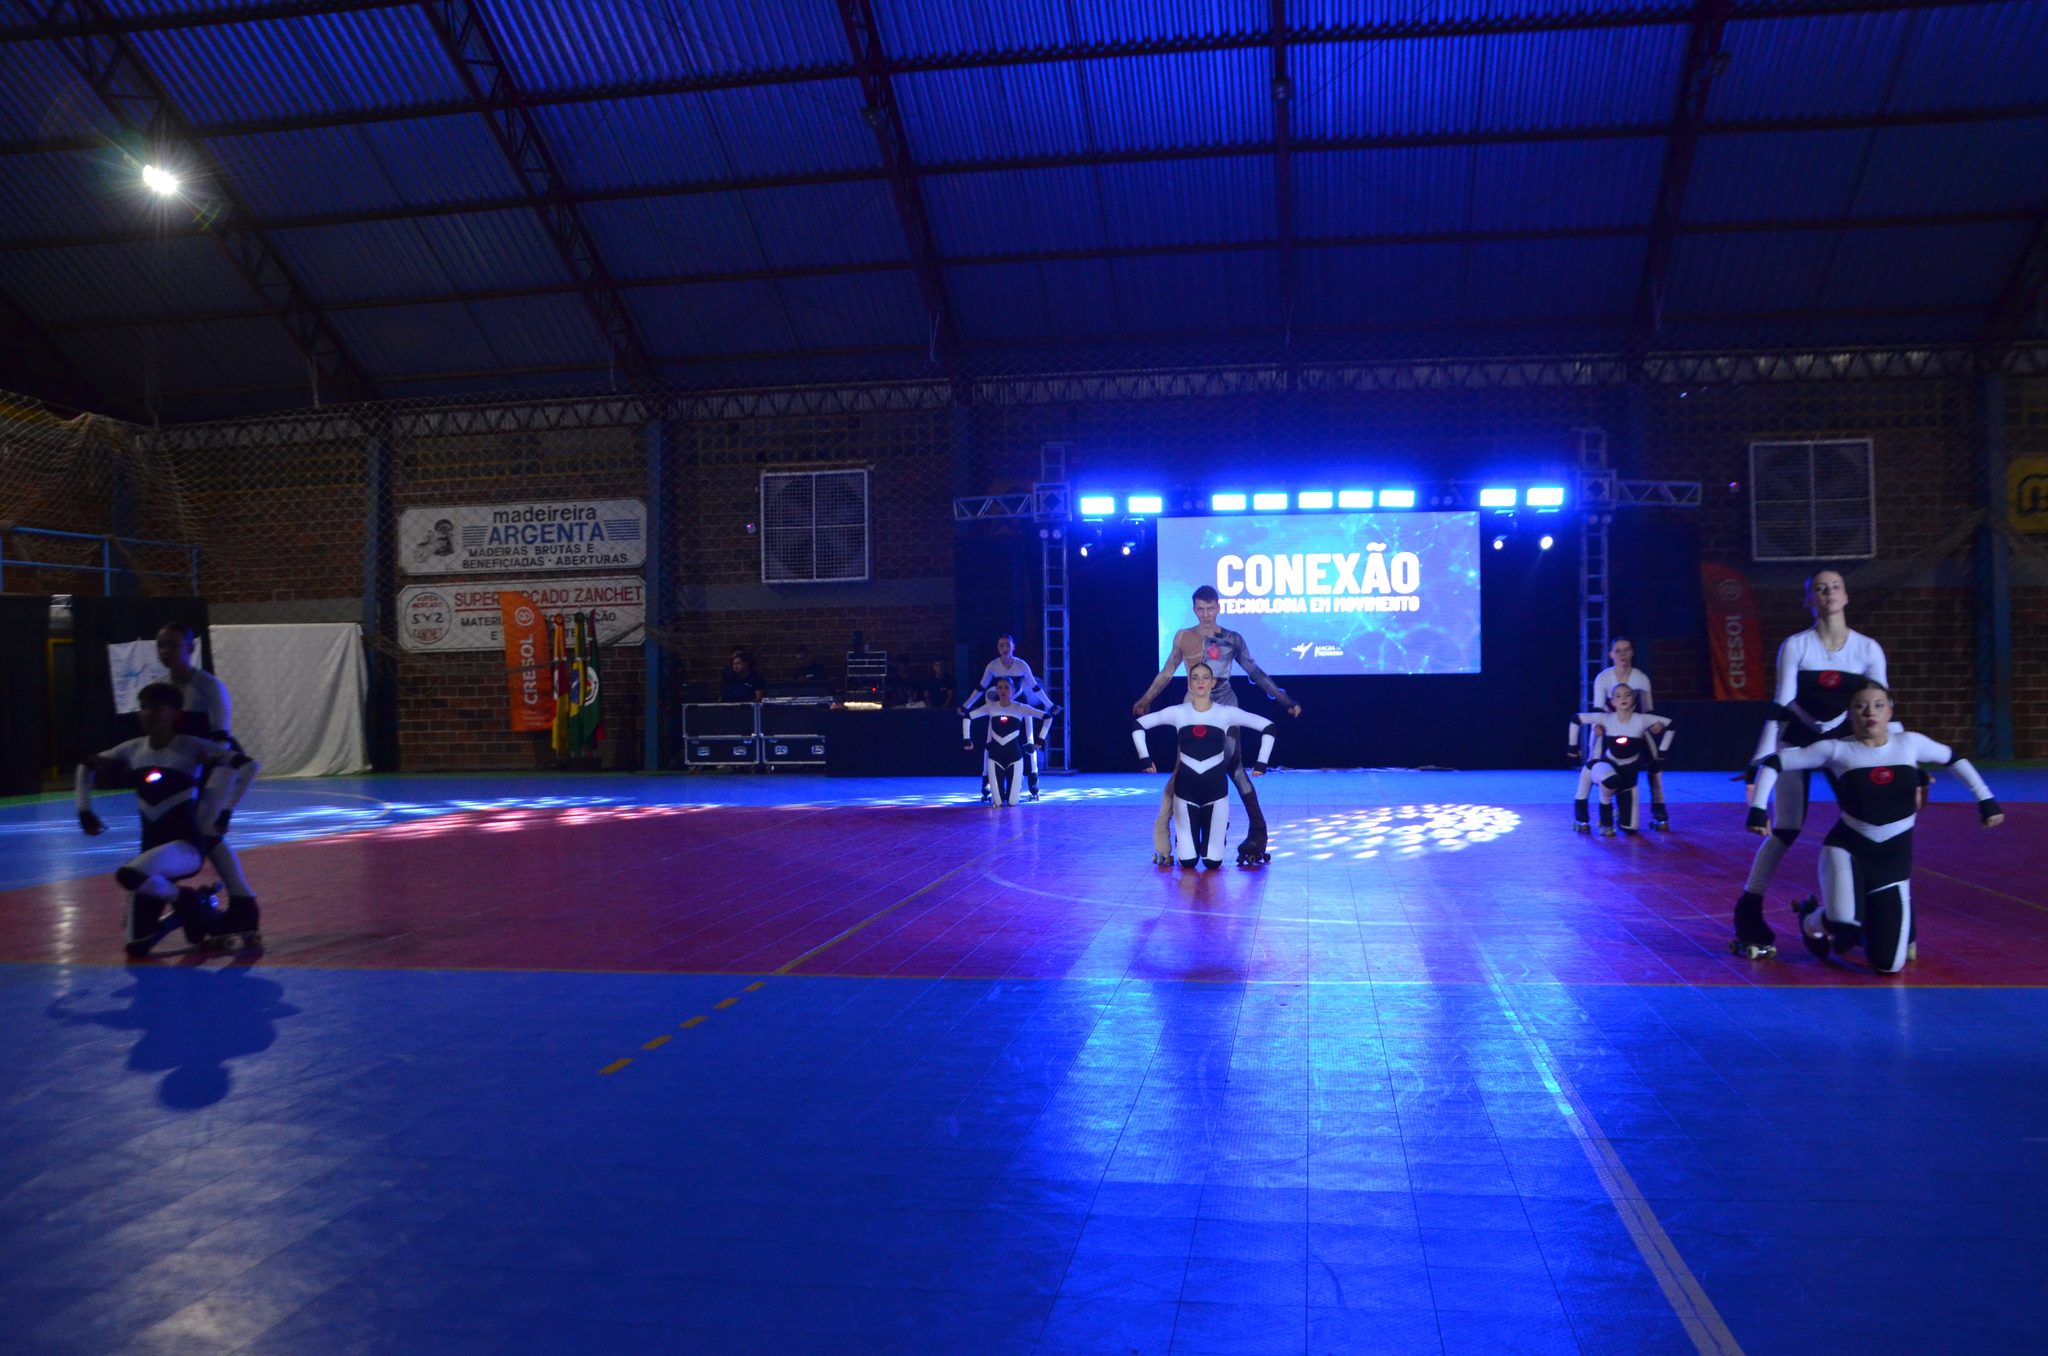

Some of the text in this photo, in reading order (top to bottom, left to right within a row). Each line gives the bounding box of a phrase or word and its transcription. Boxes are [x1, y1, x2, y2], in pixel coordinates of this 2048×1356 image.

[493, 505, 597, 524] madeireira
[488, 522, 606, 546] ARGENTA
[468, 543, 595, 558] MADEIRAS BRUTAS E
[462, 553, 629, 570] BENEFICIADAS ABERTURAS
[1216, 541, 1420, 597] CONEXÃO
[574, 585, 643, 604] ZANCHET
[1218, 595, 1421, 615] TECNOLOGIA EM MOVIMENTO
[520, 633, 538, 705] CRESOL
